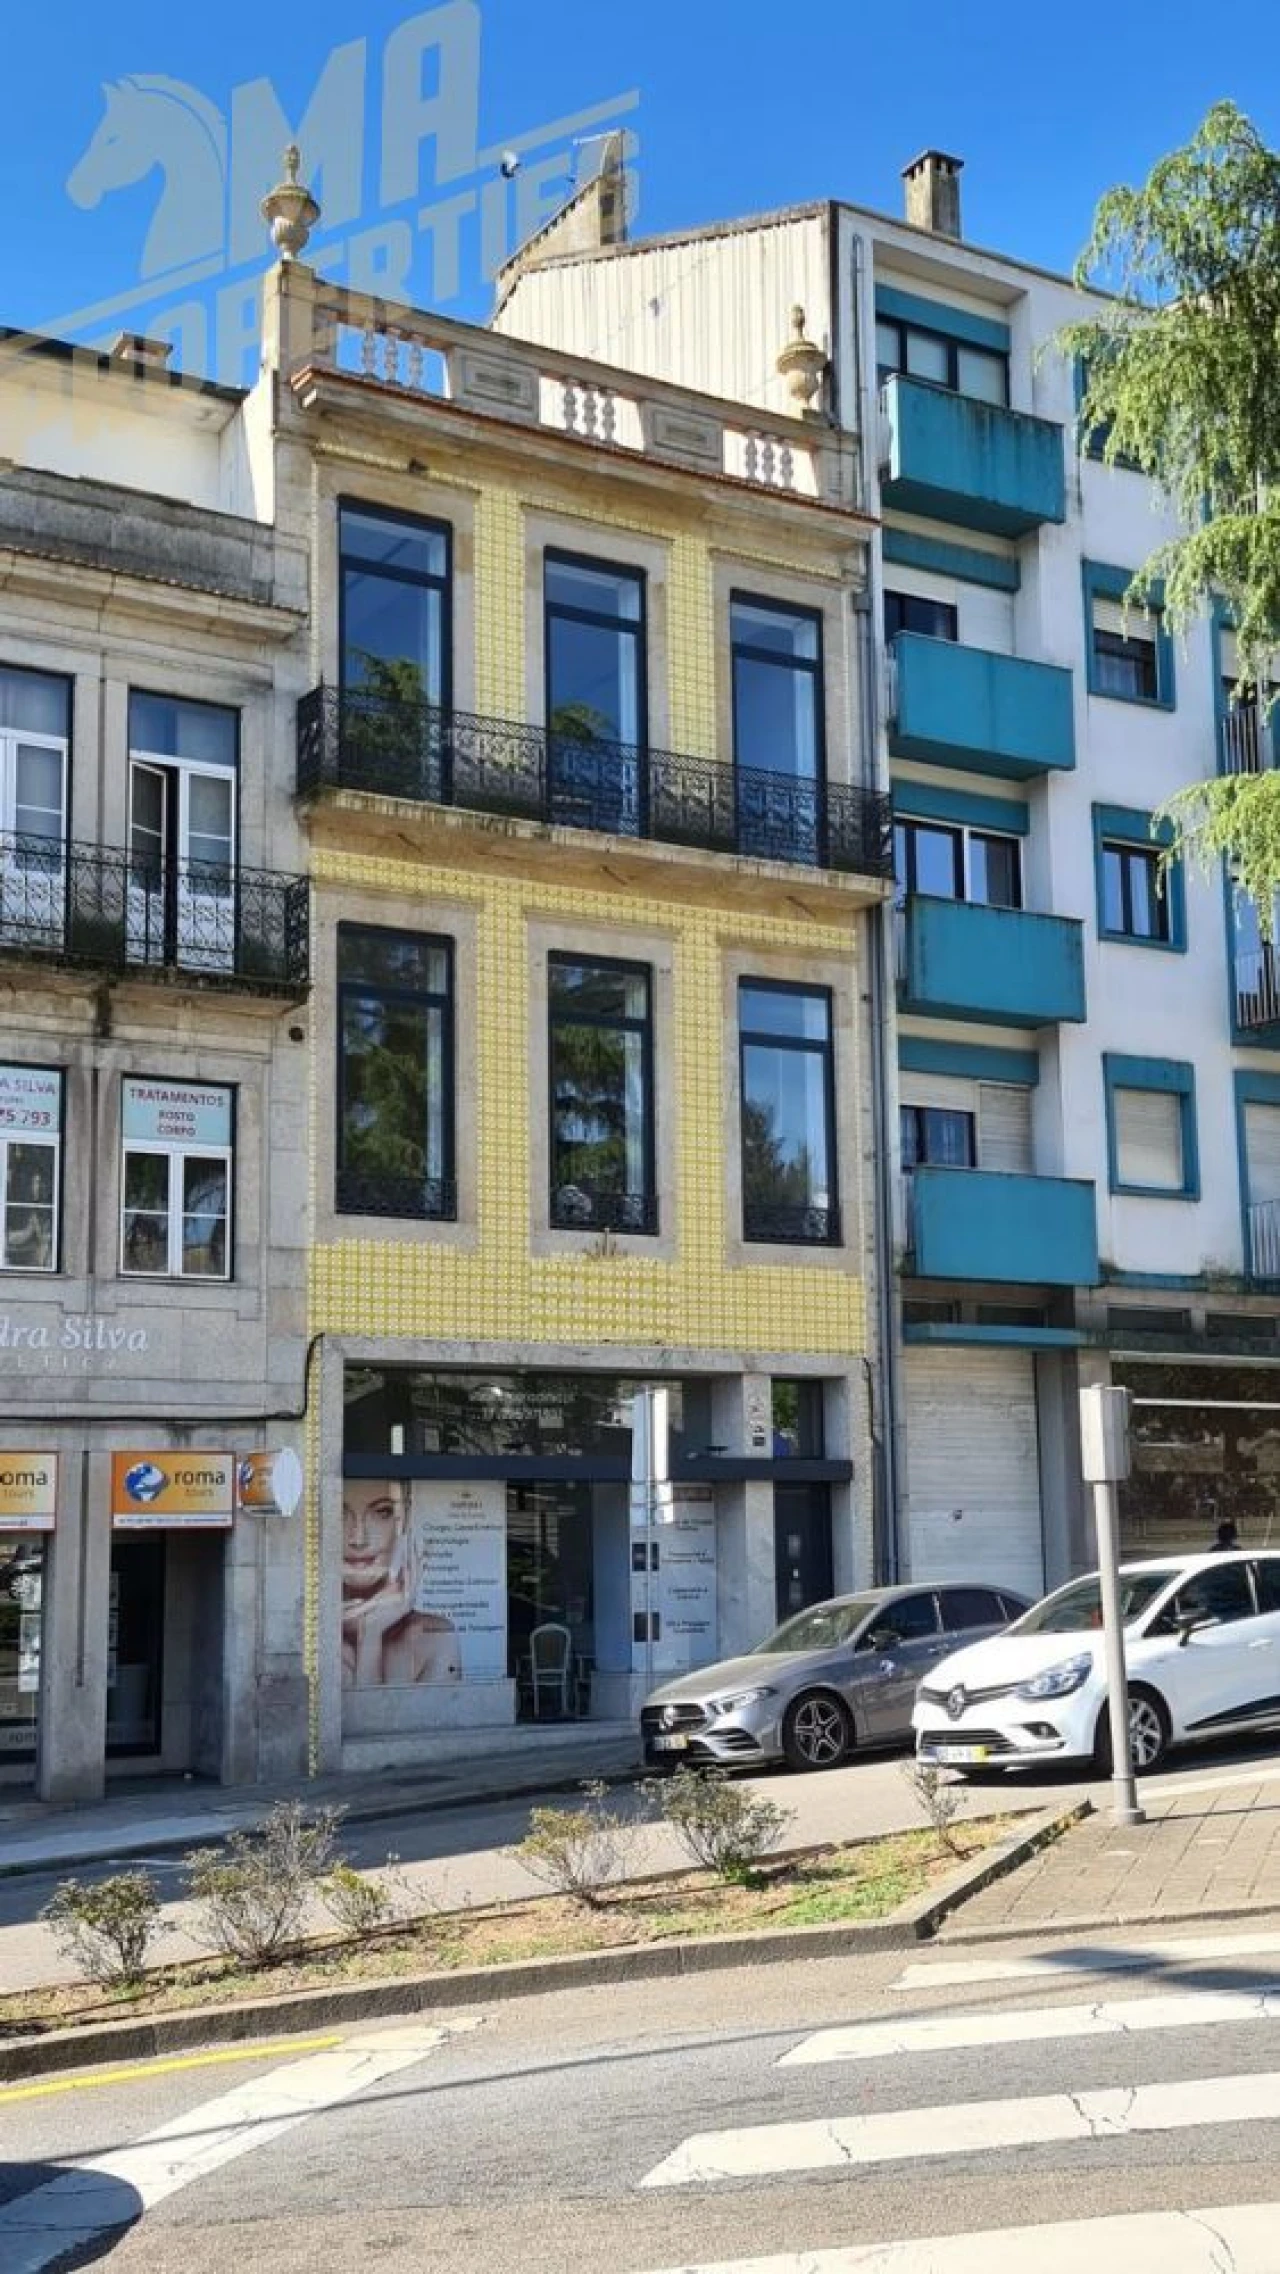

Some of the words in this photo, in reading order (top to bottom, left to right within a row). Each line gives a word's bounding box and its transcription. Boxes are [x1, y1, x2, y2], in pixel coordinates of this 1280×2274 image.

[129, 1086, 224, 1107] TRATAMENTOS
[159, 1110, 196, 1122] ROSTO
[157, 1125, 196, 1137] CORPO
[59, 1317, 149, 1352] Silva
[174, 1469, 226, 1486] roma
